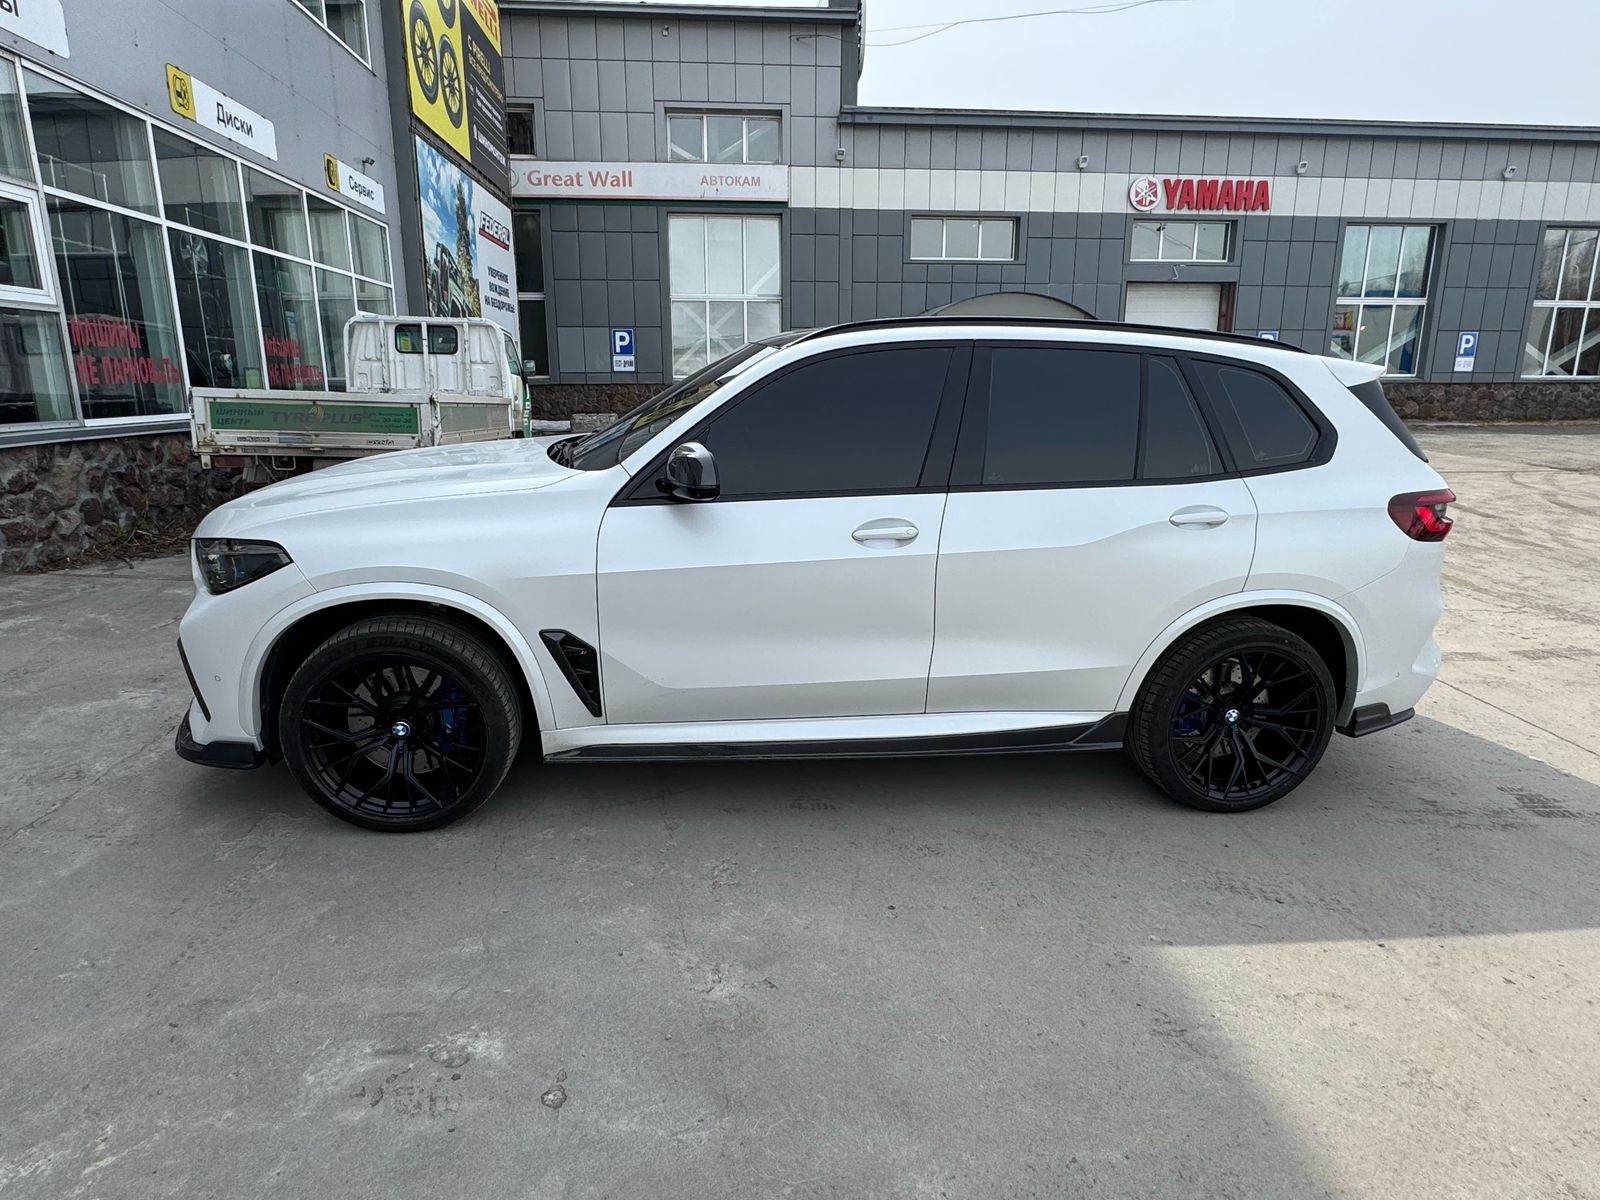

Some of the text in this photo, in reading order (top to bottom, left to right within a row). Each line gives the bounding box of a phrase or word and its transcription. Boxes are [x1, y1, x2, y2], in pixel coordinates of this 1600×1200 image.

[216, 102, 254, 138] Диски
[348, 175, 375, 201] Сервис
[526, 170, 633, 188] Great Wall
[700, 175, 761, 187] АВТОКАМ
[1163, 178, 1271, 212] YAMAHA
[480, 212, 510, 246] FEDERAL
[69, 319, 142, 349] МАШИНЫ
[615, 331, 630, 353] P
[1459, 334, 1475, 355] P
[76, 355, 99, 385] НЕ
[216, 406, 264, 416] ШИННЫЙ
[217, 417, 251, 427] ЦЕНТР
[271, 411, 316, 424] TYRE
[321, 412, 362, 425] PLUS
